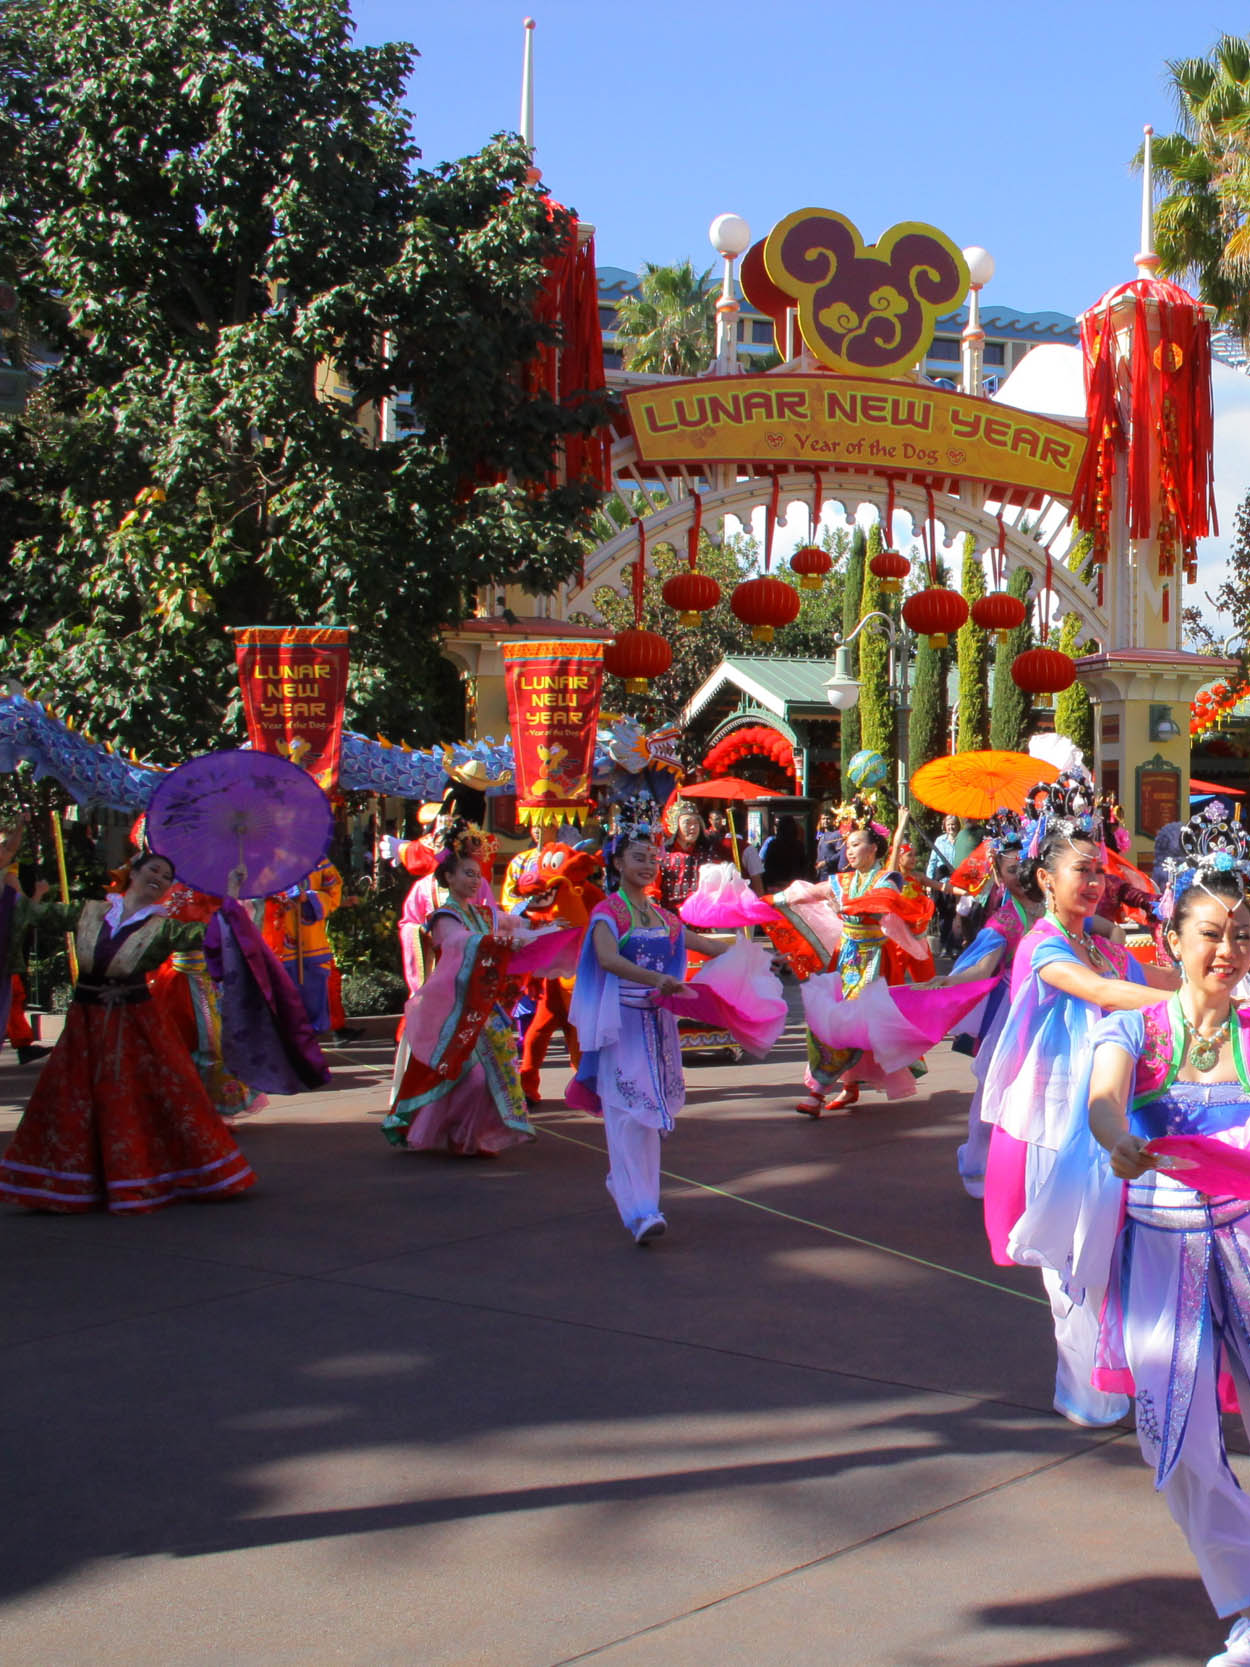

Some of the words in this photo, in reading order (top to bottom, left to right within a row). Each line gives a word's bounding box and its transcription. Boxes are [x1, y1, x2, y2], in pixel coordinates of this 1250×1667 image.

[642, 389, 810, 434] LUNAR
[826, 390, 934, 432] NEW
[950, 406, 1074, 472] YEAR
[794, 433, 840, 453] Year
[845, 438, 865, 455] of
[868, 440, 896, 457] the
[903, 442, 939, 465] Dog
[254, 665, 331, 679] LUNAR
[521, 676, 589, 690] LUNAR
[268, 683, 320, 698] NEW
[531, 693, 577, 707] NEW
[261, 703, 327, 717] YEAR
[526, 711, 583, 725] YEAR
